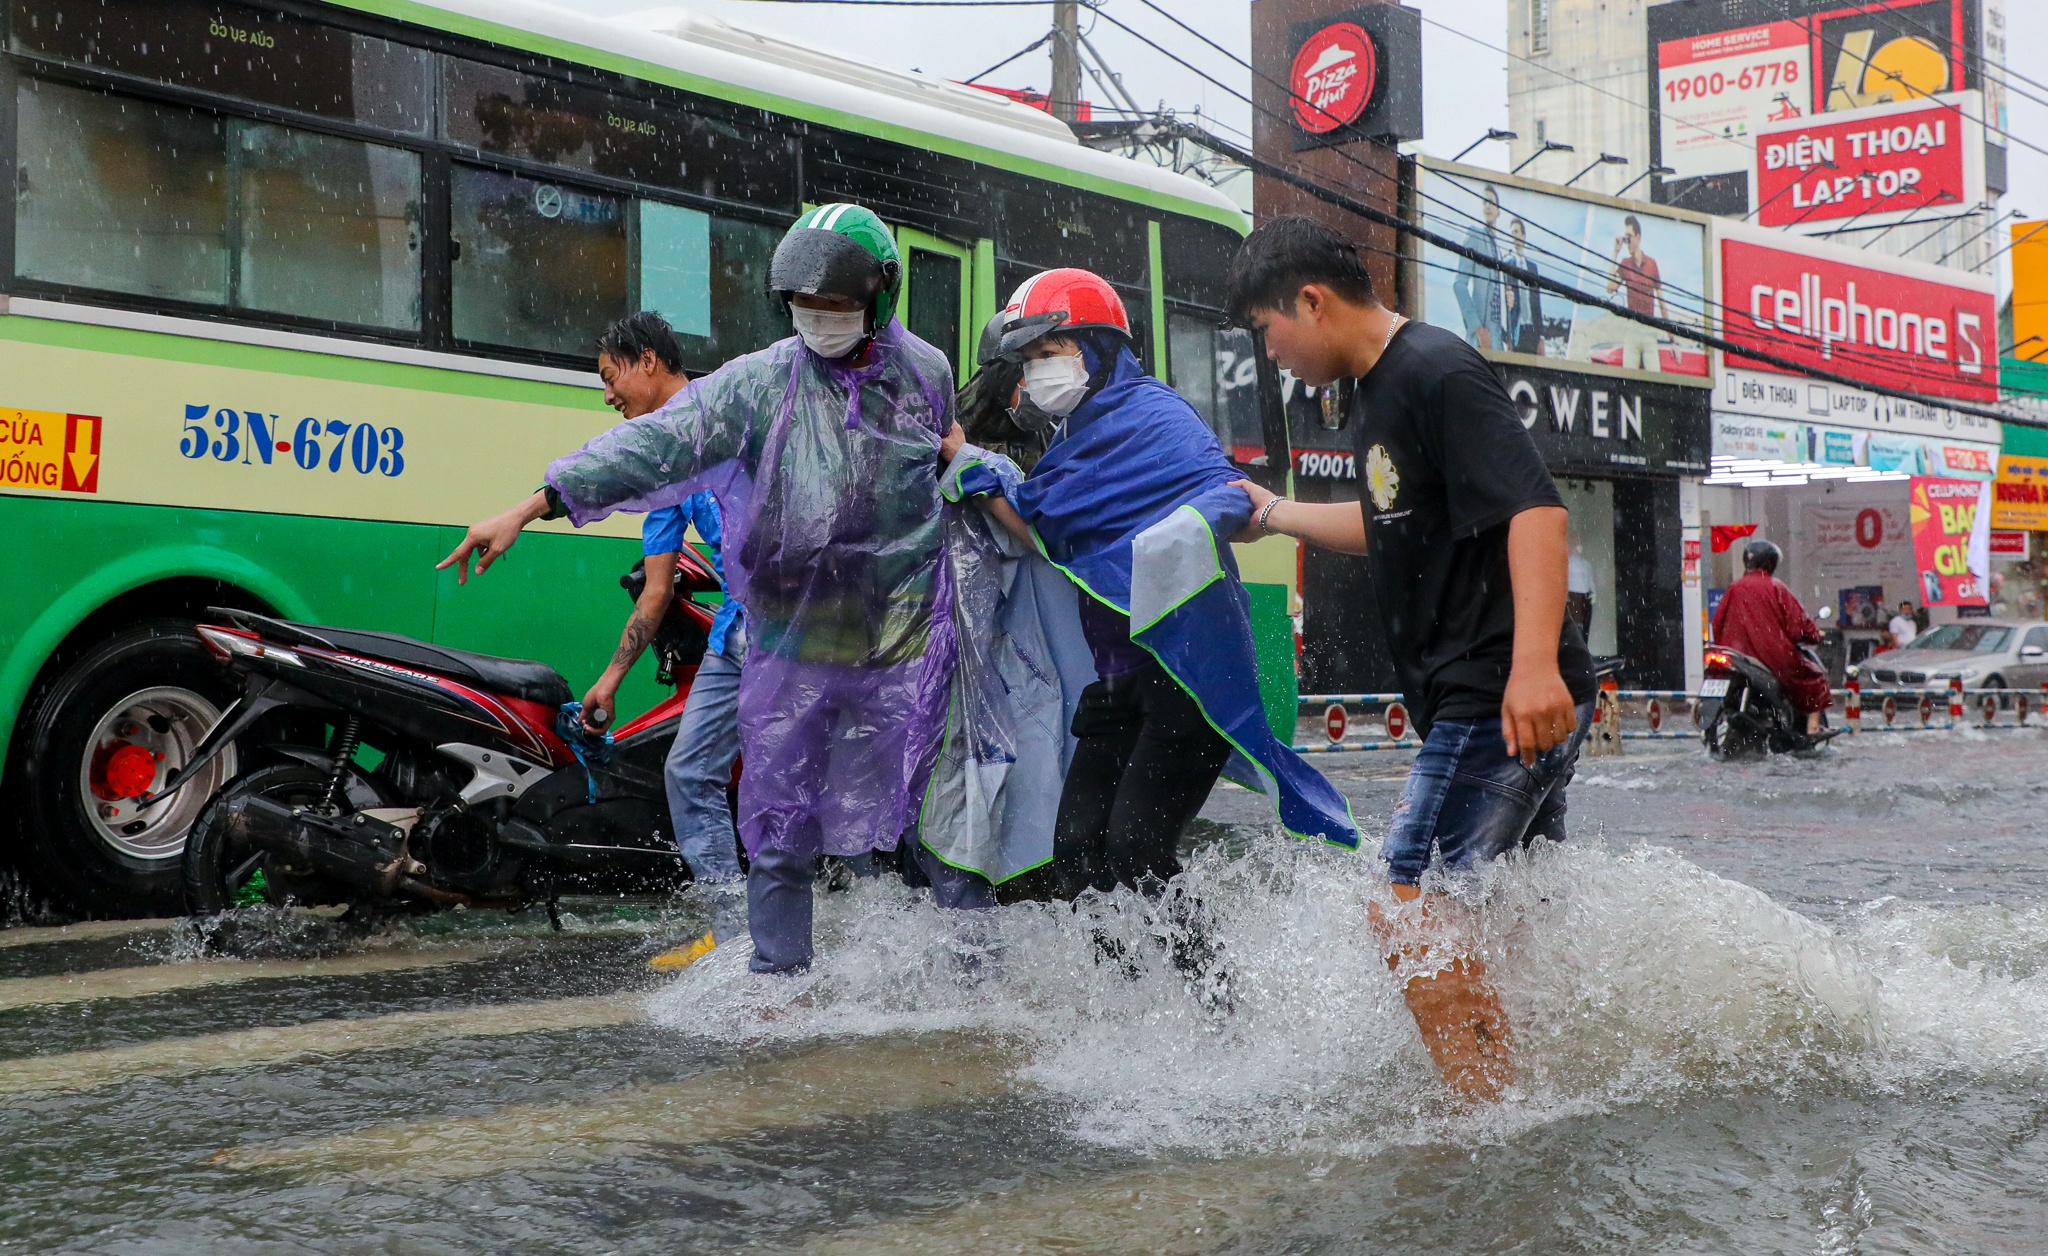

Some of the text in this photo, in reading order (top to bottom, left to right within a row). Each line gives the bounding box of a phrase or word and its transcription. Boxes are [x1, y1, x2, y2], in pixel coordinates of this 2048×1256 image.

[1691, 28, 1769, 51] HOME SERVICE
[1305, 64, 1358, 107] Pizza
[1315, 81, 1351, 114] Hut
[1665, 60, 1799, 103] 1900-6778
[1764, 134, 1835, 171] ĐIỆN
[1846, 120, 1946, 155] THOẠI
[1793, 167, 1921, 208] LAPTOP
[1751, 272, 1948, 361] cellphone
[1510, 380, 1643, 440] OWEN
[1742, 379, 1798, 408] ĐIỆN THOẠI
[1832, 394, 1868, 413] LAPTOP
[894, 407, 933, 431] Food
[180, 404, 405, 477] 53N-6703
